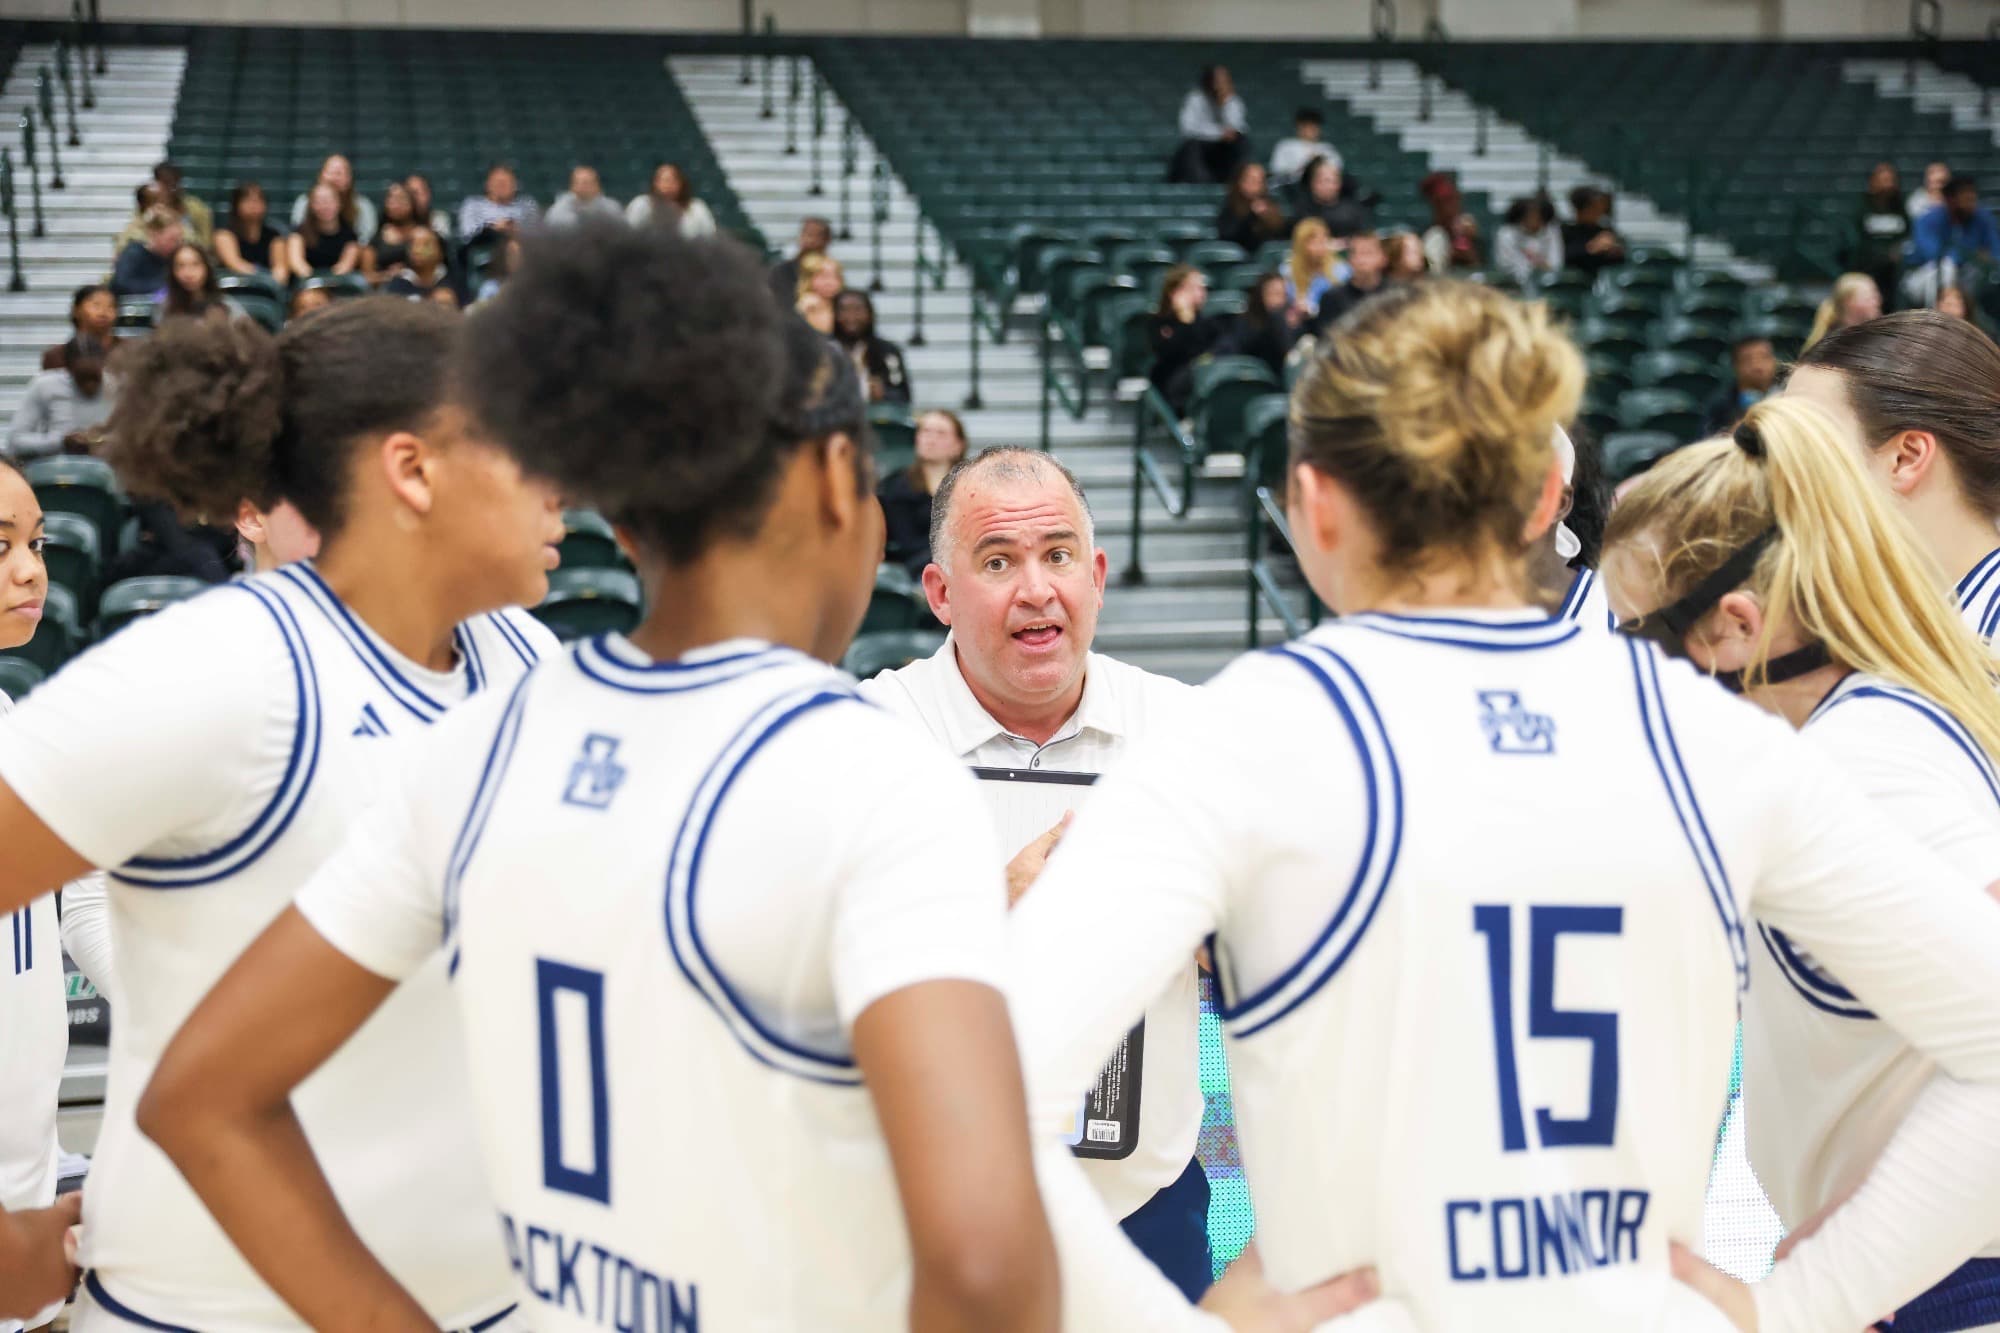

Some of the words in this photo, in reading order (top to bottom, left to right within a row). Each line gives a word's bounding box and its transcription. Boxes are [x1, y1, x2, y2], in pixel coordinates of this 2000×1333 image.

[535, 957, 611, 1206] 0
[1473, 905, 1623, 1152] 15
[1446, 1190, 1650, 1281] CONNOR
